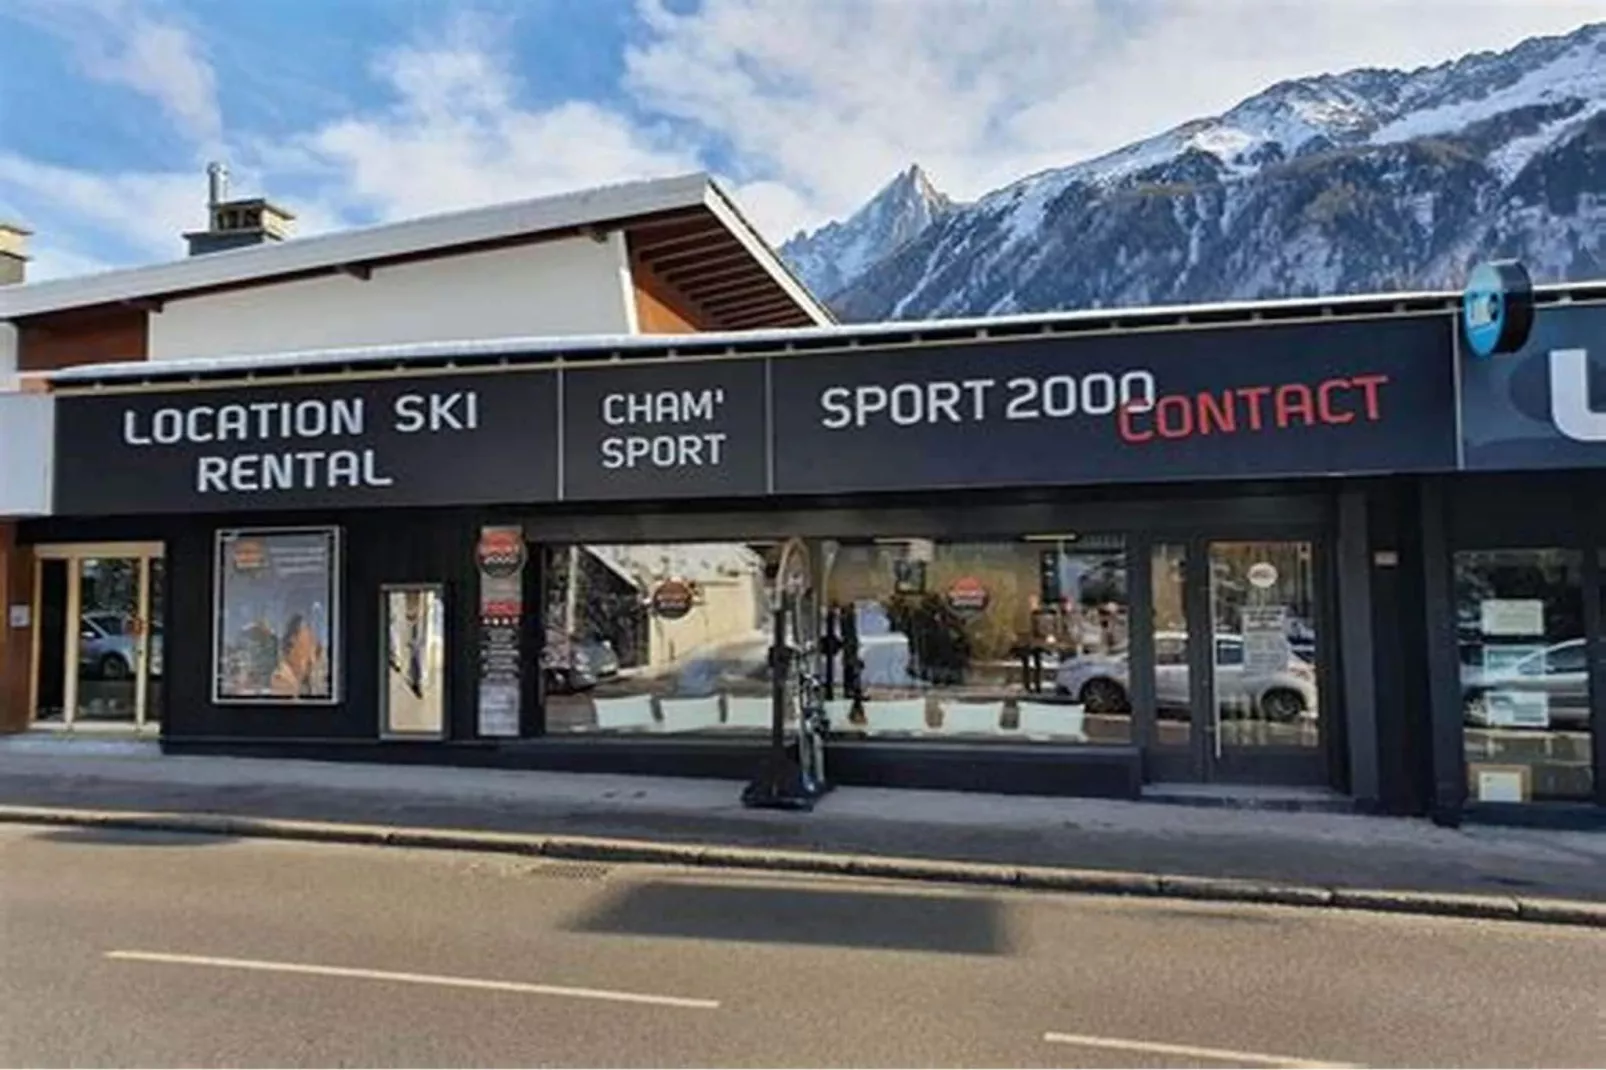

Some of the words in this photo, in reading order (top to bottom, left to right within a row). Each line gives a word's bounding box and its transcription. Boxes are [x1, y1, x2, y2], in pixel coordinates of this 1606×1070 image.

[123, 397, 364, 445] LOCATION
[394, 391, 478, 433] SKI
[602, 389, 725, 426] CHAM'
[821, 379, 995, 429] SPORT
[1006, 370, 1156, 421] 2000
[1118, 374, 1389, 442] CONTACT
[197, 449, 393, 493] RENTAL
[601, 432, 727, 470] SPORT
